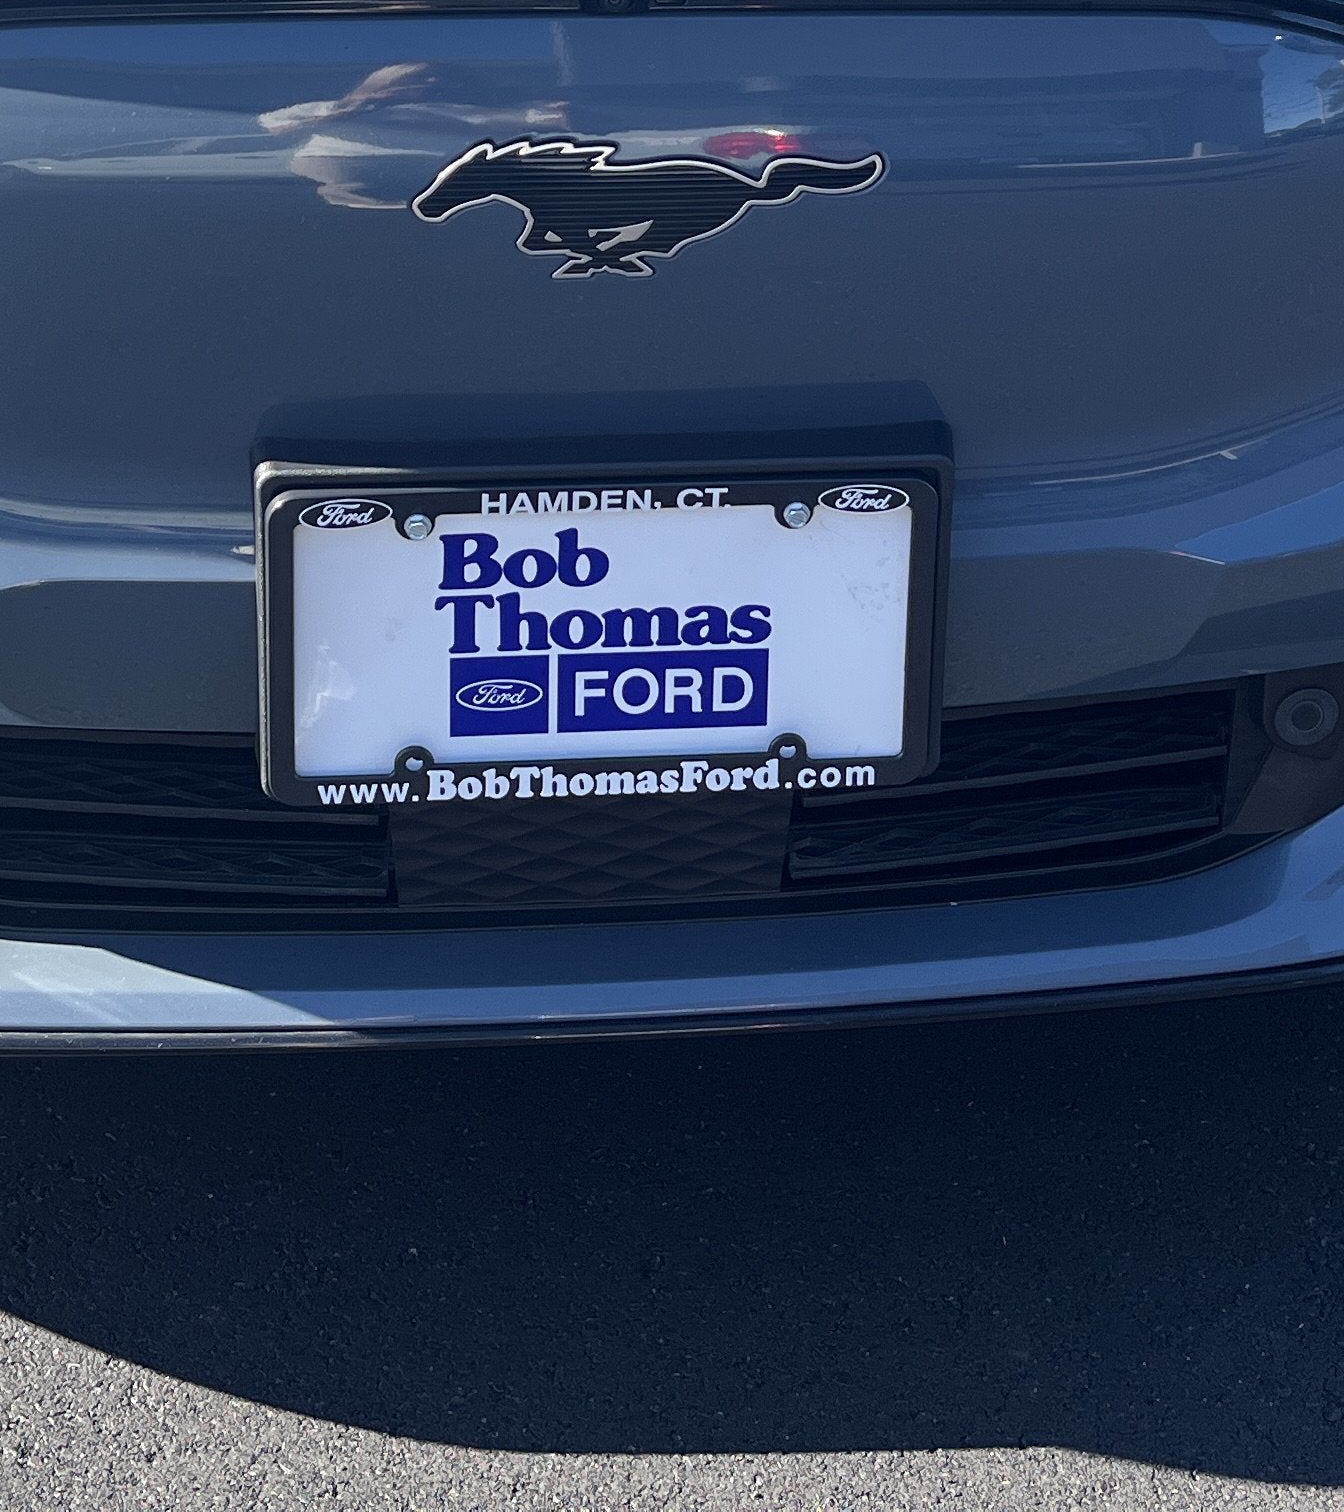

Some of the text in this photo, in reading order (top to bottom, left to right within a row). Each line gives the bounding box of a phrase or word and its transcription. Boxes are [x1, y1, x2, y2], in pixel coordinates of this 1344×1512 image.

[317, 503, 375, 526] Ford
[481, 487, 731, 516] HAMDEN, CT.
[835, 488, 893, 509] Ford
[437, 528, 610, 591] Bob
[434, 592, 773, 654] Thomas
[472, 684, 527, 704] Ford
[573, 666, 754, 718] FORD
[317, 758, 876, 805] www.BobThomasFord.com
